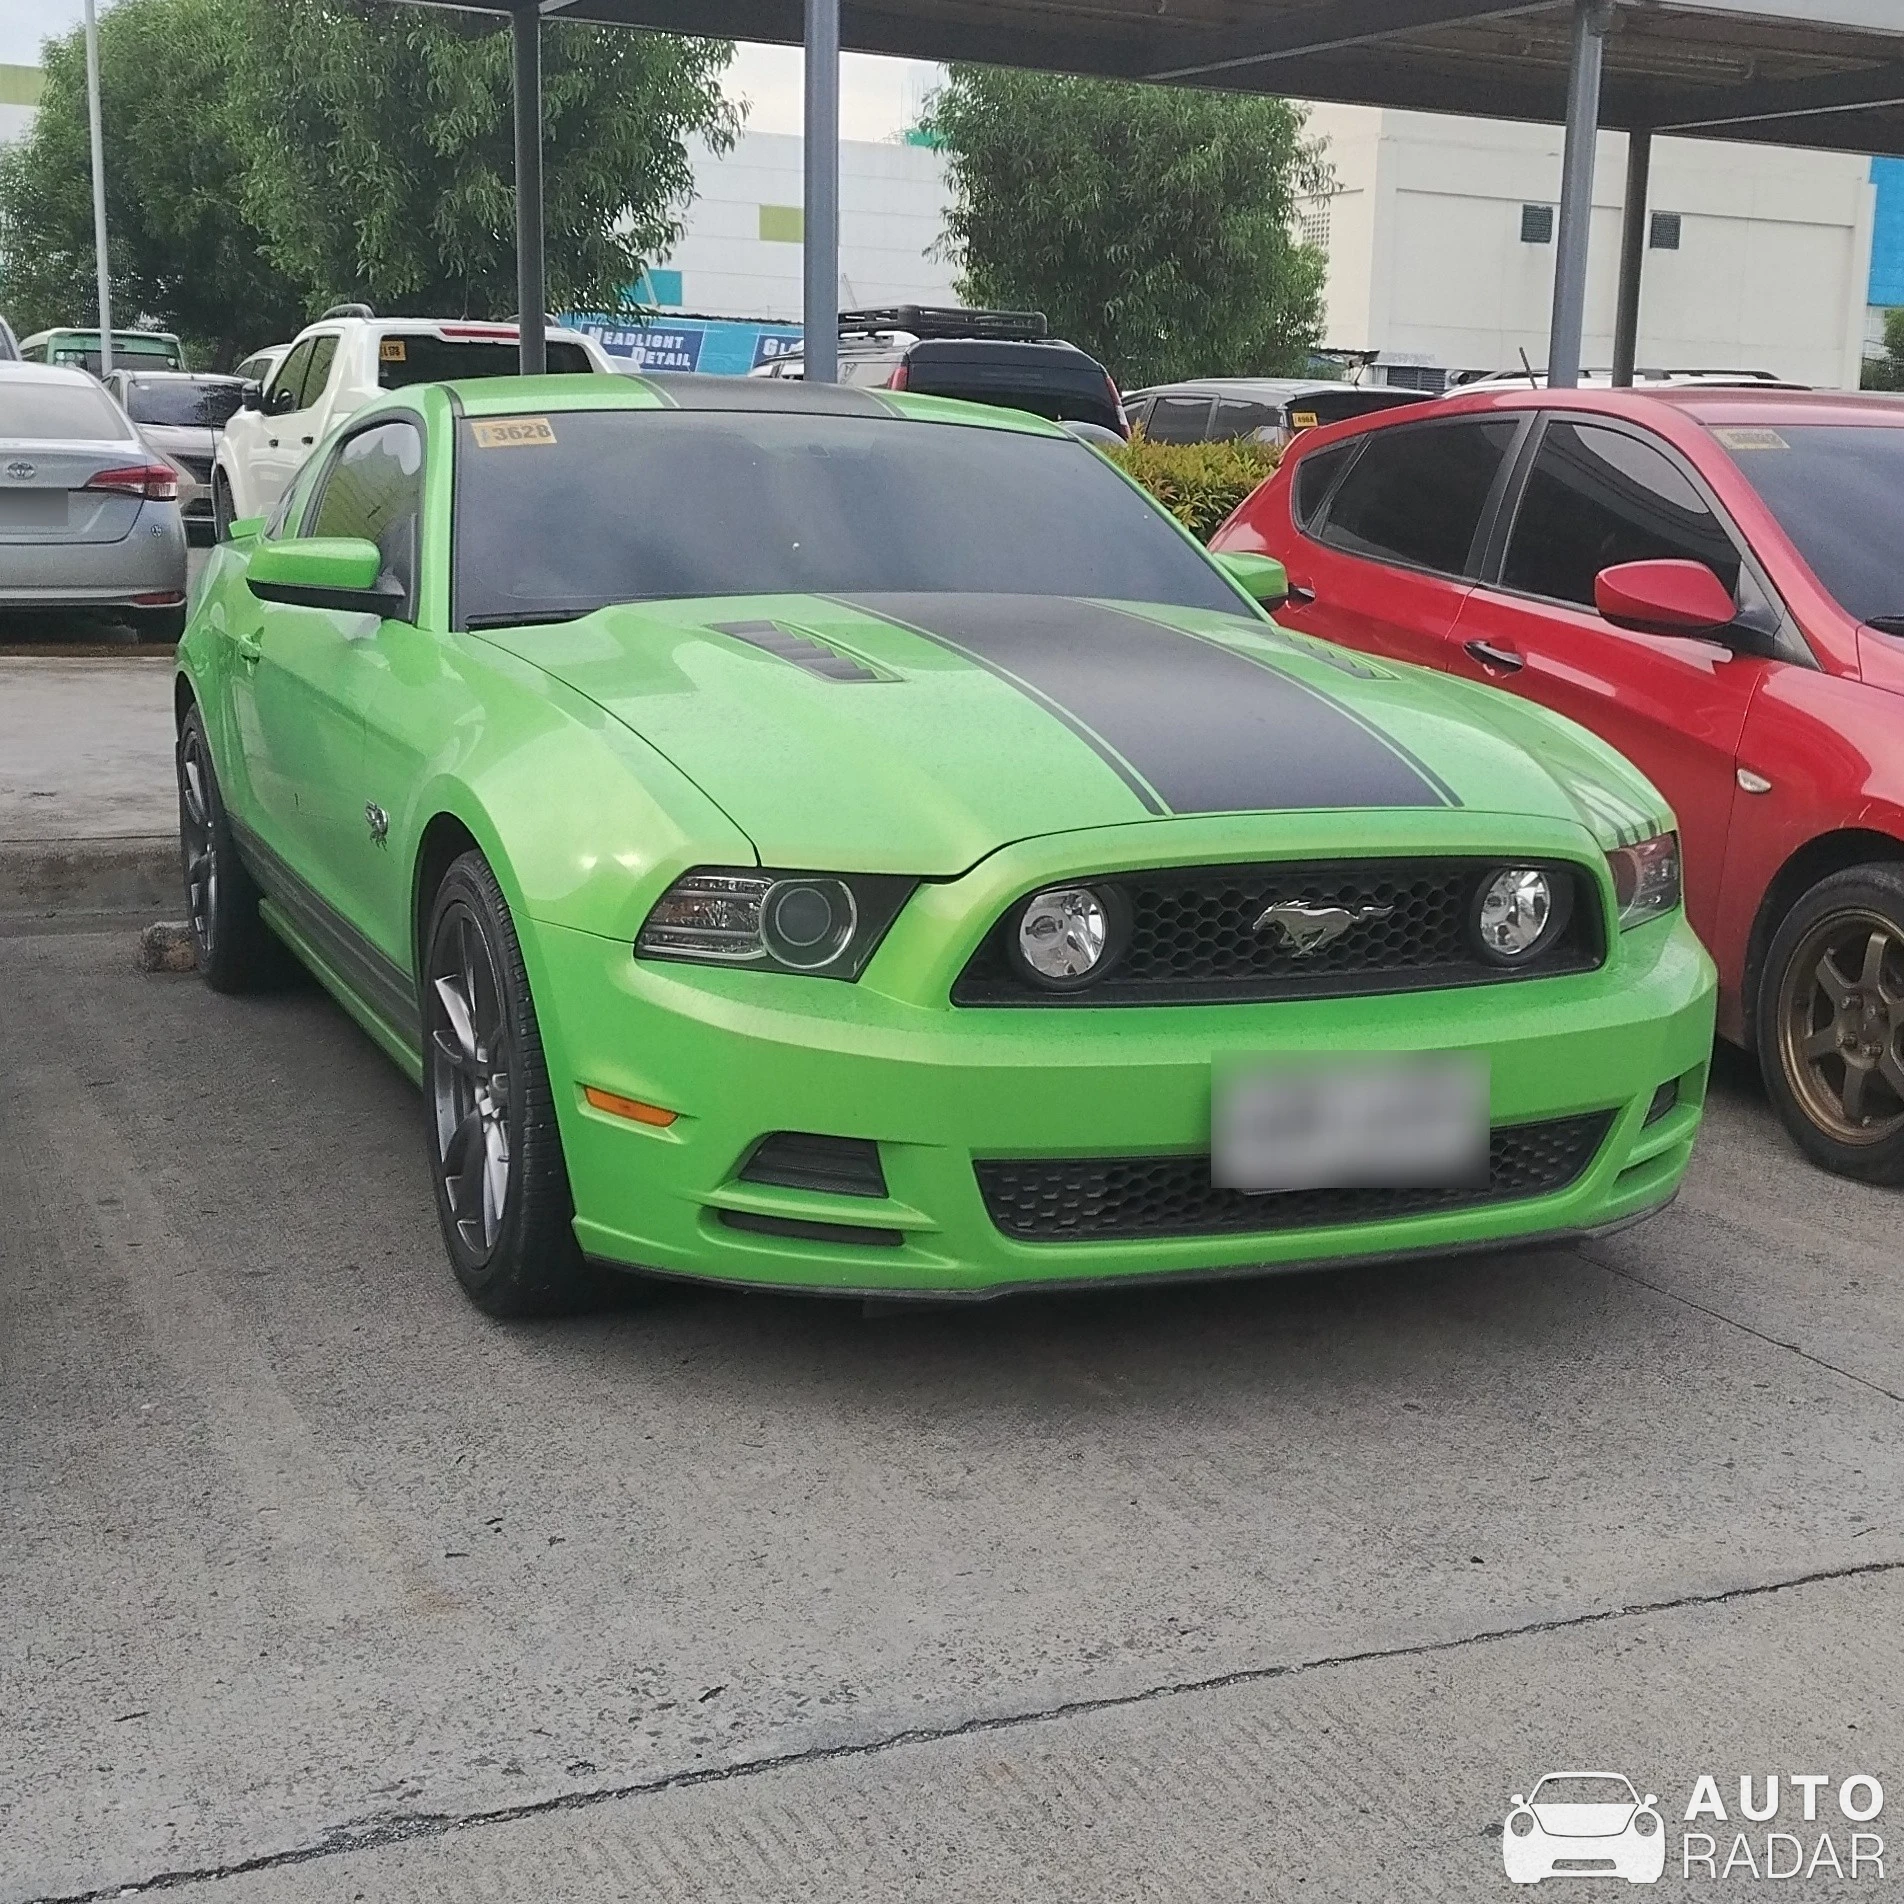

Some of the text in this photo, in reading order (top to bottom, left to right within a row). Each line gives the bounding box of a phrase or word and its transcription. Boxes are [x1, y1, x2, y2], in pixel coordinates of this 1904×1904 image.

[588, 326, 685, 349] HEADLIGHT
[631, 346, 691, 366] DETAIL
[491, 424, 552, 441] 3628
